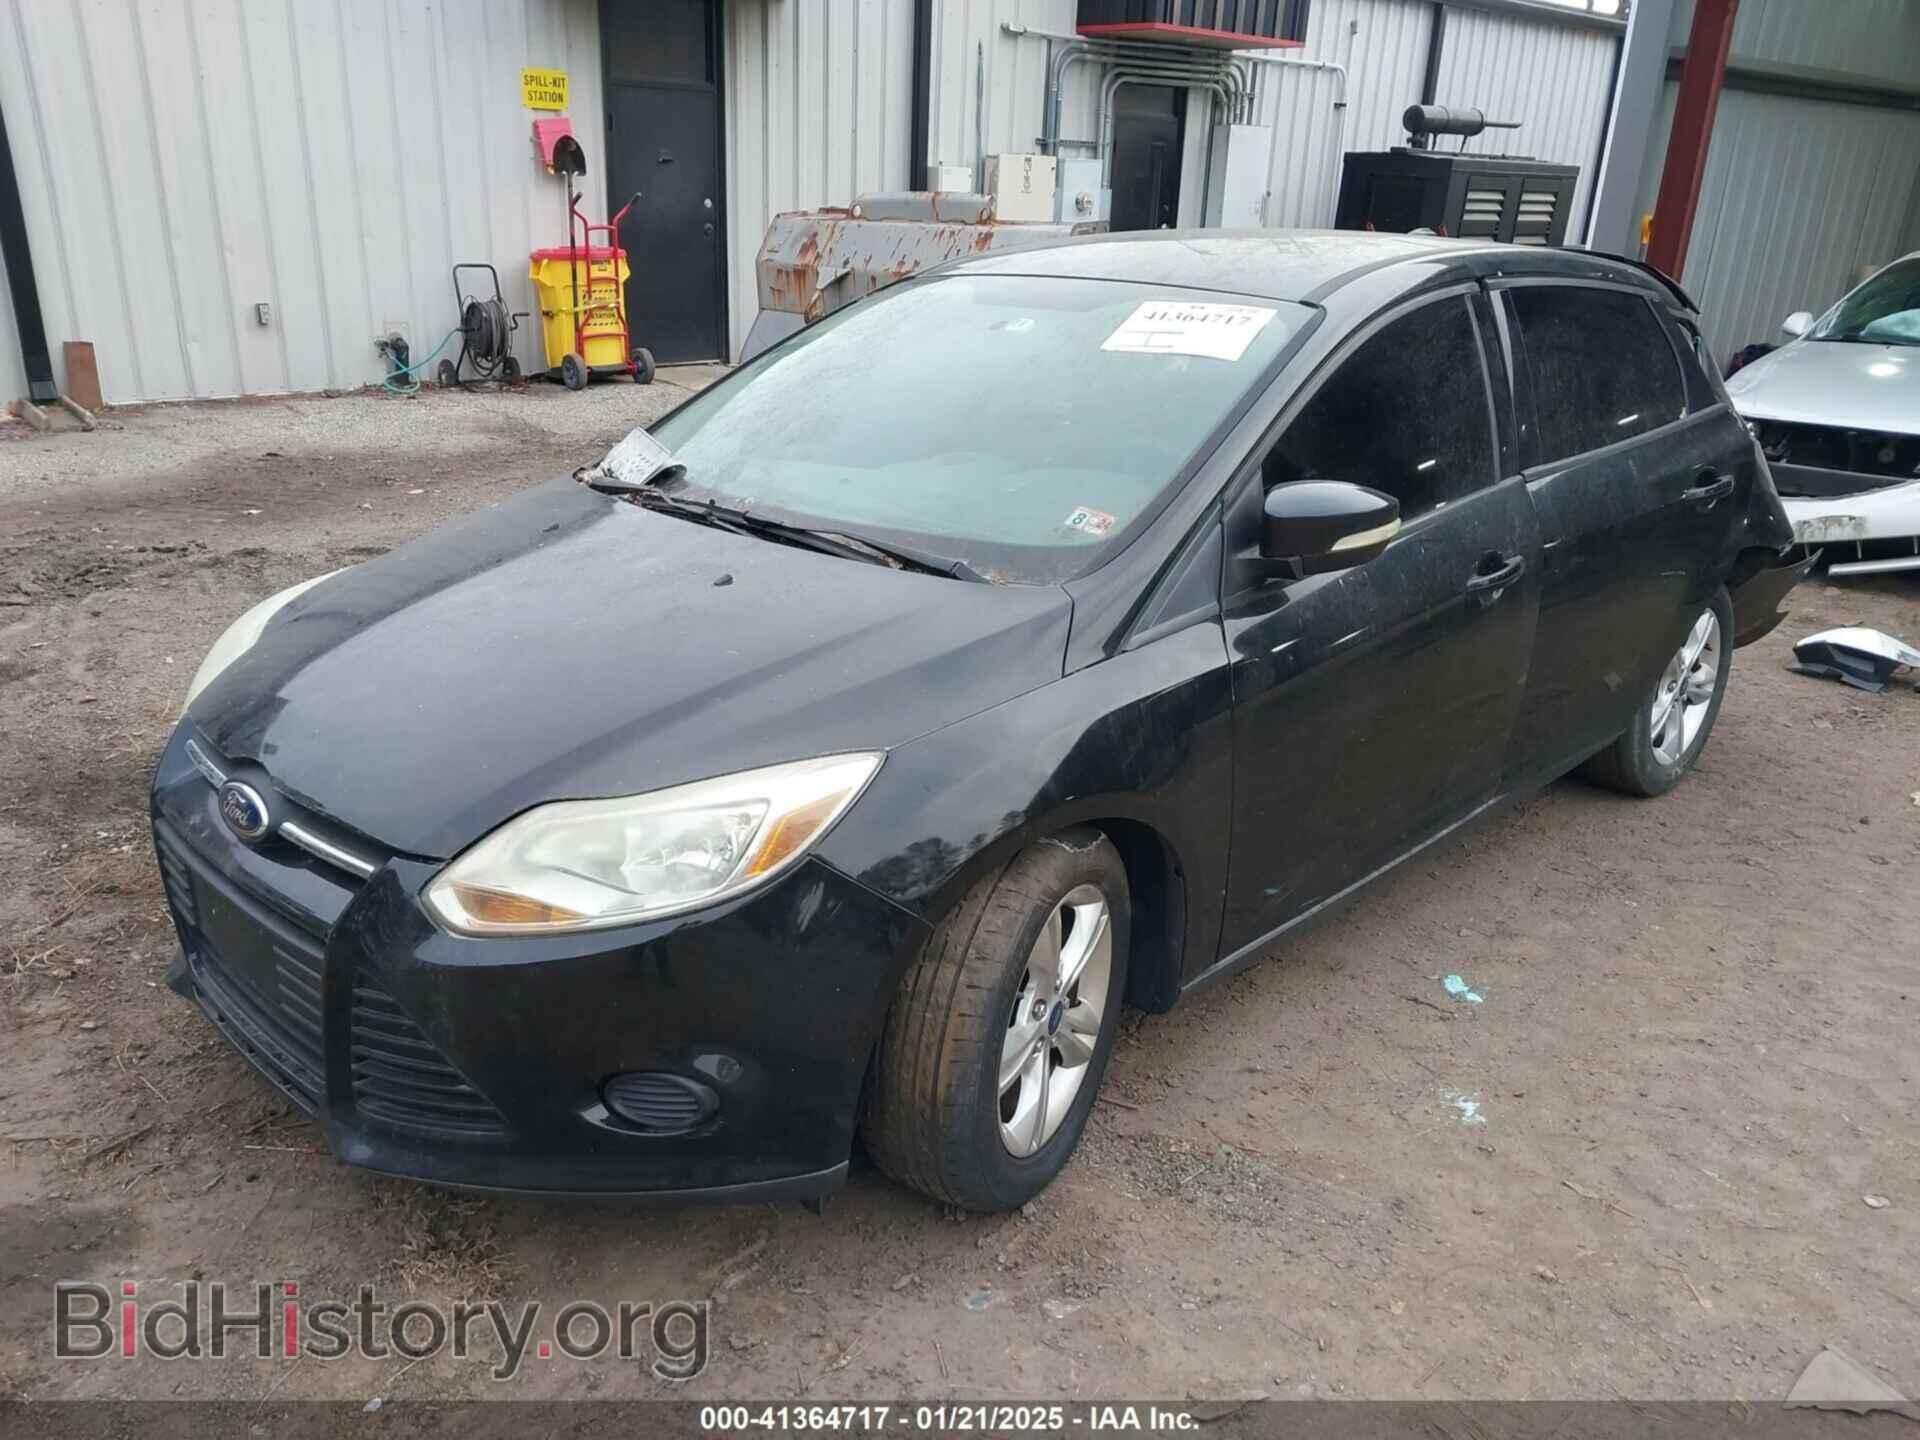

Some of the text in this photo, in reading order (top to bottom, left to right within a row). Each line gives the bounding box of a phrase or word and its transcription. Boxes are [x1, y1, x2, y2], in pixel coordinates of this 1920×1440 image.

[523, 74, 566, 88] SPILL-KIT
[527, 90, 564, 103] STATION
[1072, 512, 1088, 525] 8
[224, 789, 249, 827] Ford
